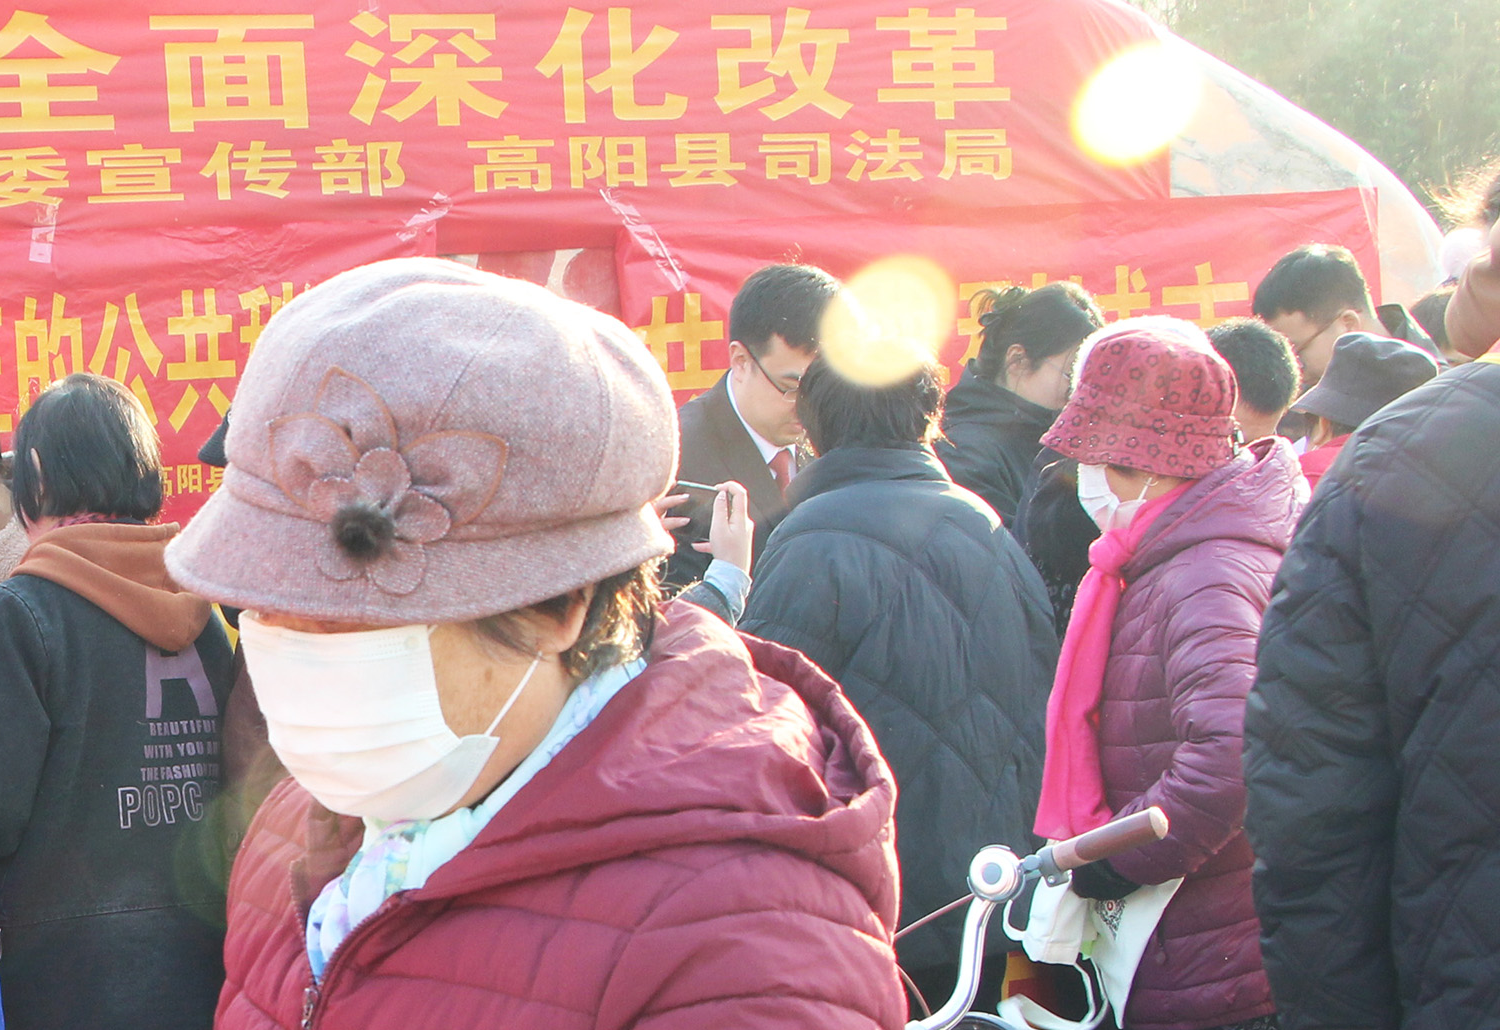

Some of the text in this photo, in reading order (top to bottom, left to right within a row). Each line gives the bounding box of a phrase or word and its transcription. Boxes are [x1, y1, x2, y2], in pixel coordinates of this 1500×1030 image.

[467, 128, 1014, 194] 高阳县司法局
[143, 744, 173, 759] WITH
[176, 741, 204, 757] YOU
